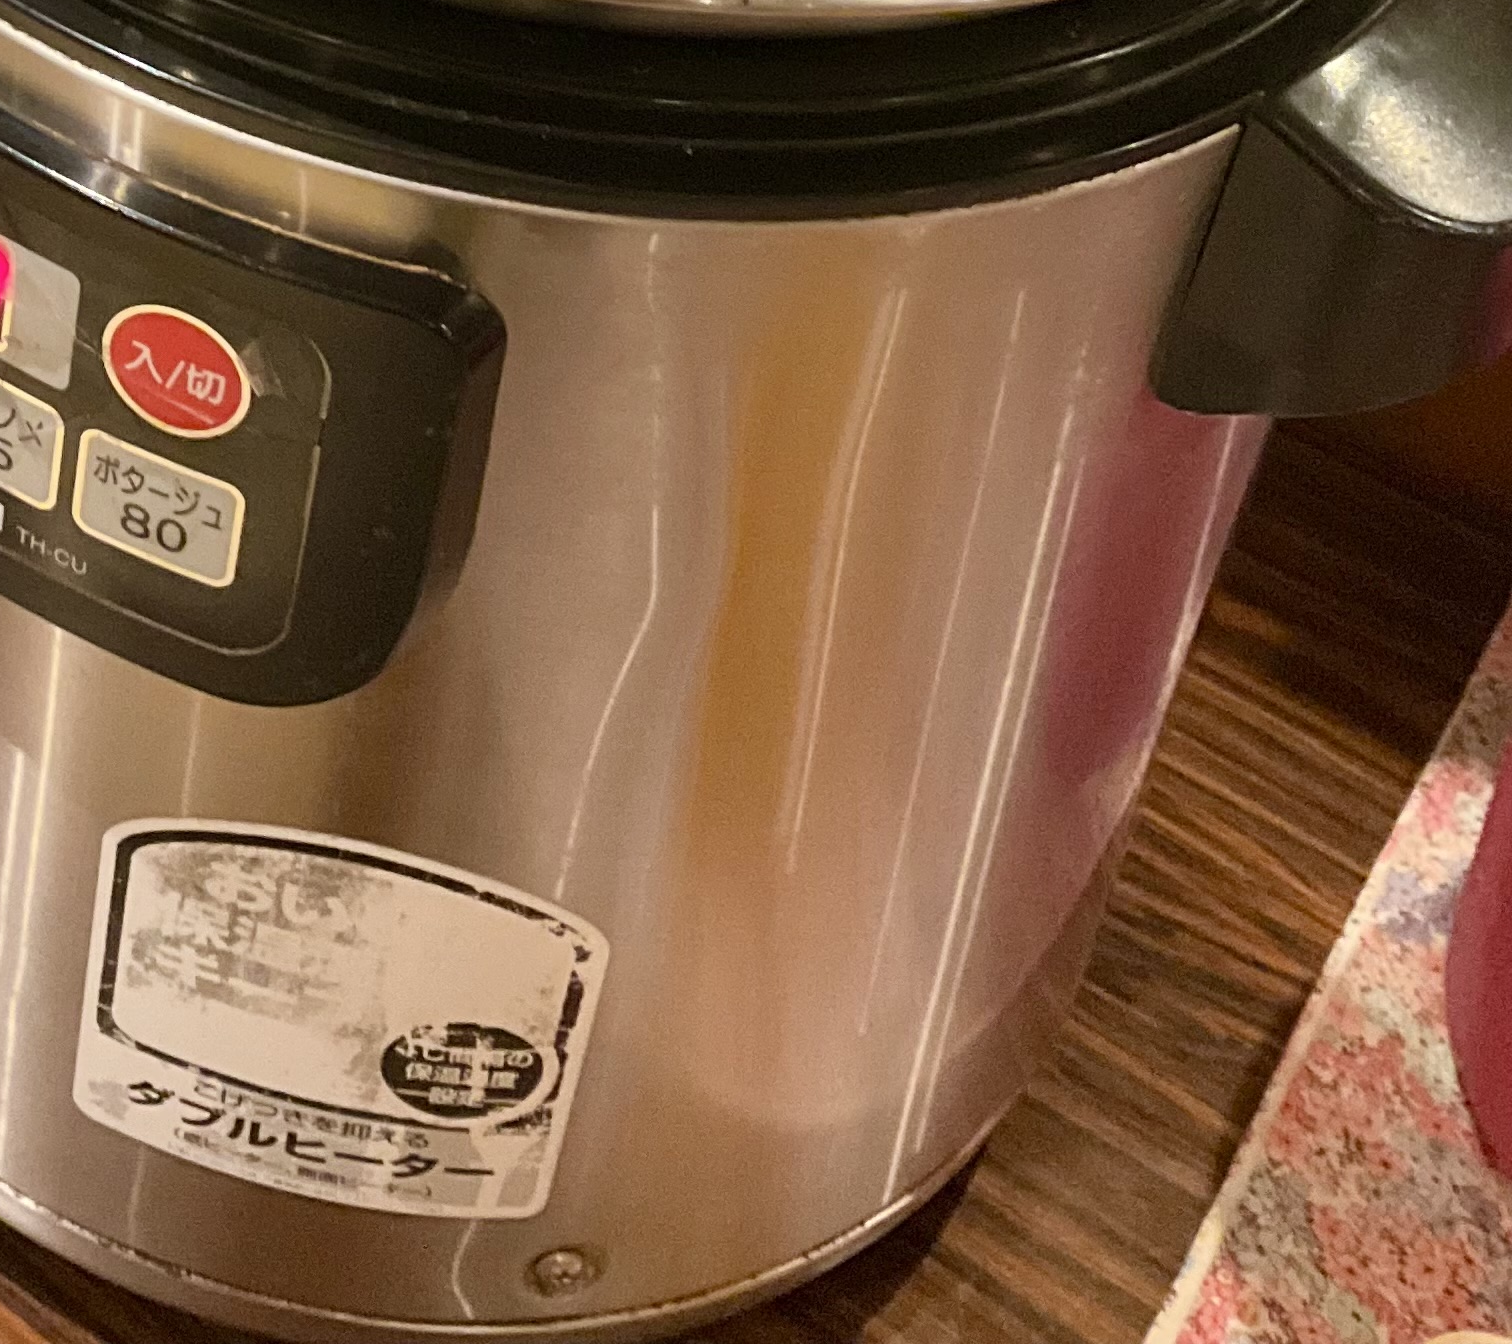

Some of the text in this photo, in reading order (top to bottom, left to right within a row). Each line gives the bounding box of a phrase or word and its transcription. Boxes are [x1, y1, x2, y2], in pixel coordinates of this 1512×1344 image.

[125, 339, 227, 406] 入/切
[93, 455, 222, 531] ポタージュ
[120, 503, 188, 553] 80
[127, 1080, 496, 1179] ダブルヒーター
